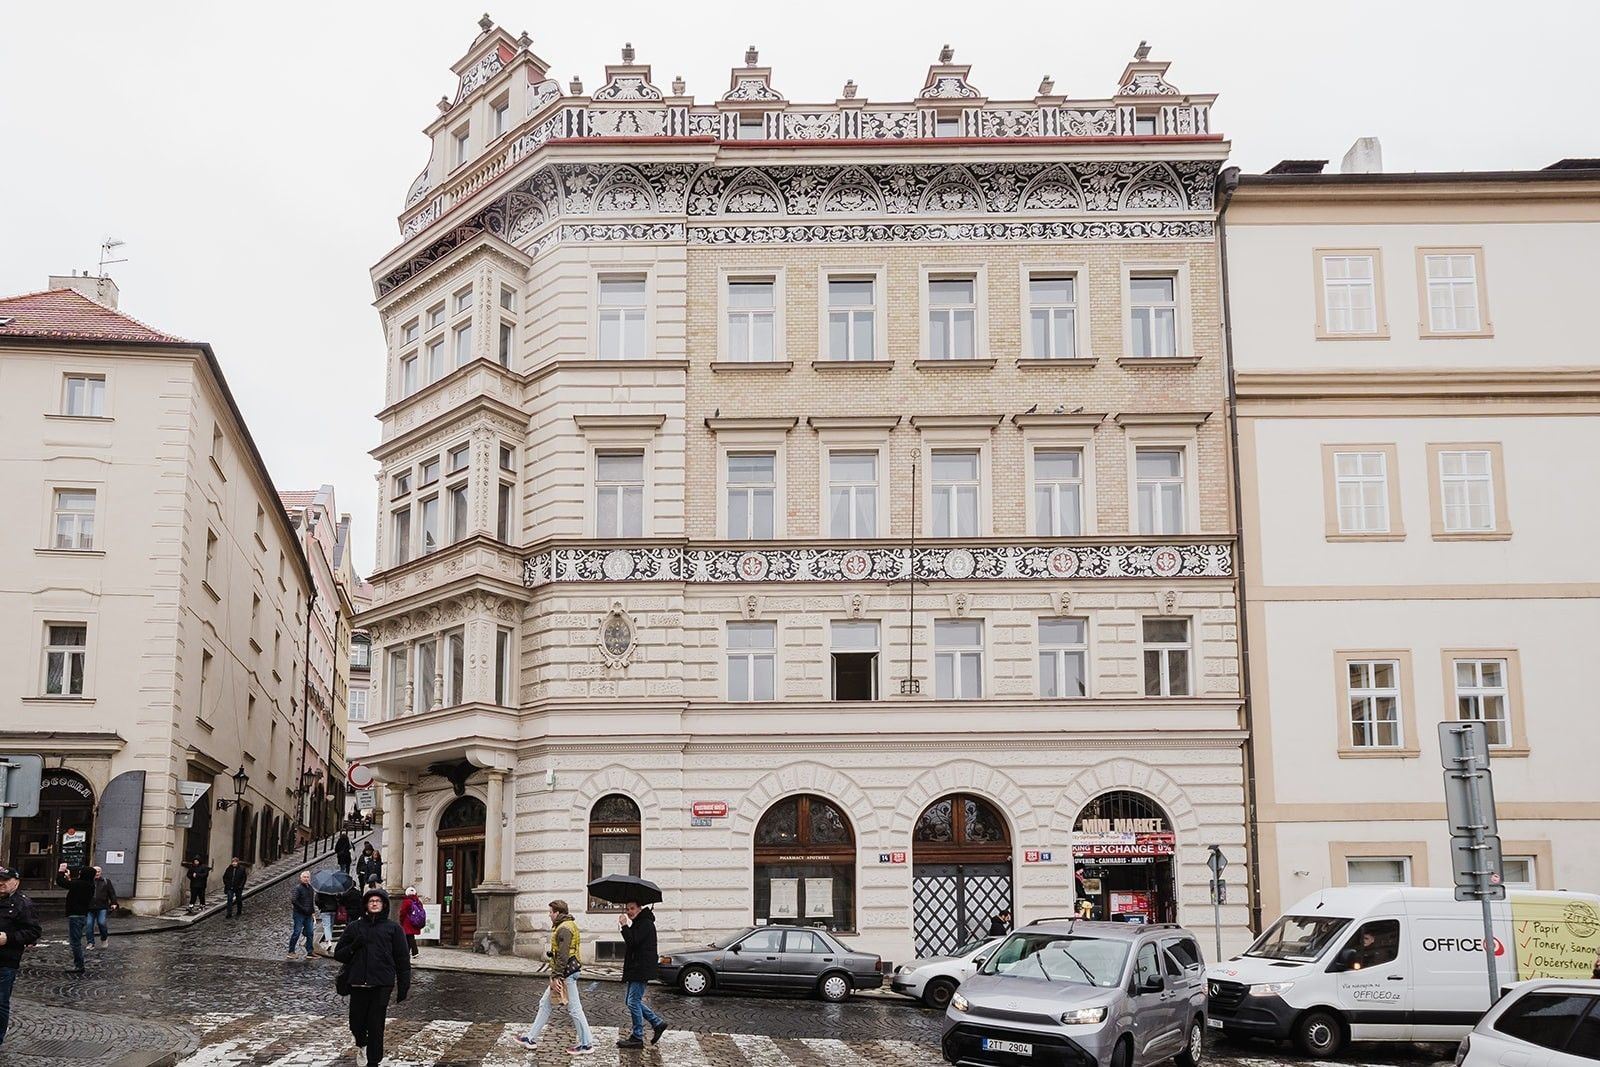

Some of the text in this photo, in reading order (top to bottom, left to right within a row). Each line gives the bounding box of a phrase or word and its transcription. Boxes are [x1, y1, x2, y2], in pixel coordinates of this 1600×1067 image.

[40, 778, 92, 798] OCOURA
[1082, 818, 1162, 832] MINI MARKET
[1093, 845, 1155, 854] EXCHANGE
[1570, 942, 1597, 954] šanon
[989, 1041, 1028, 1053] 2TT 2904
